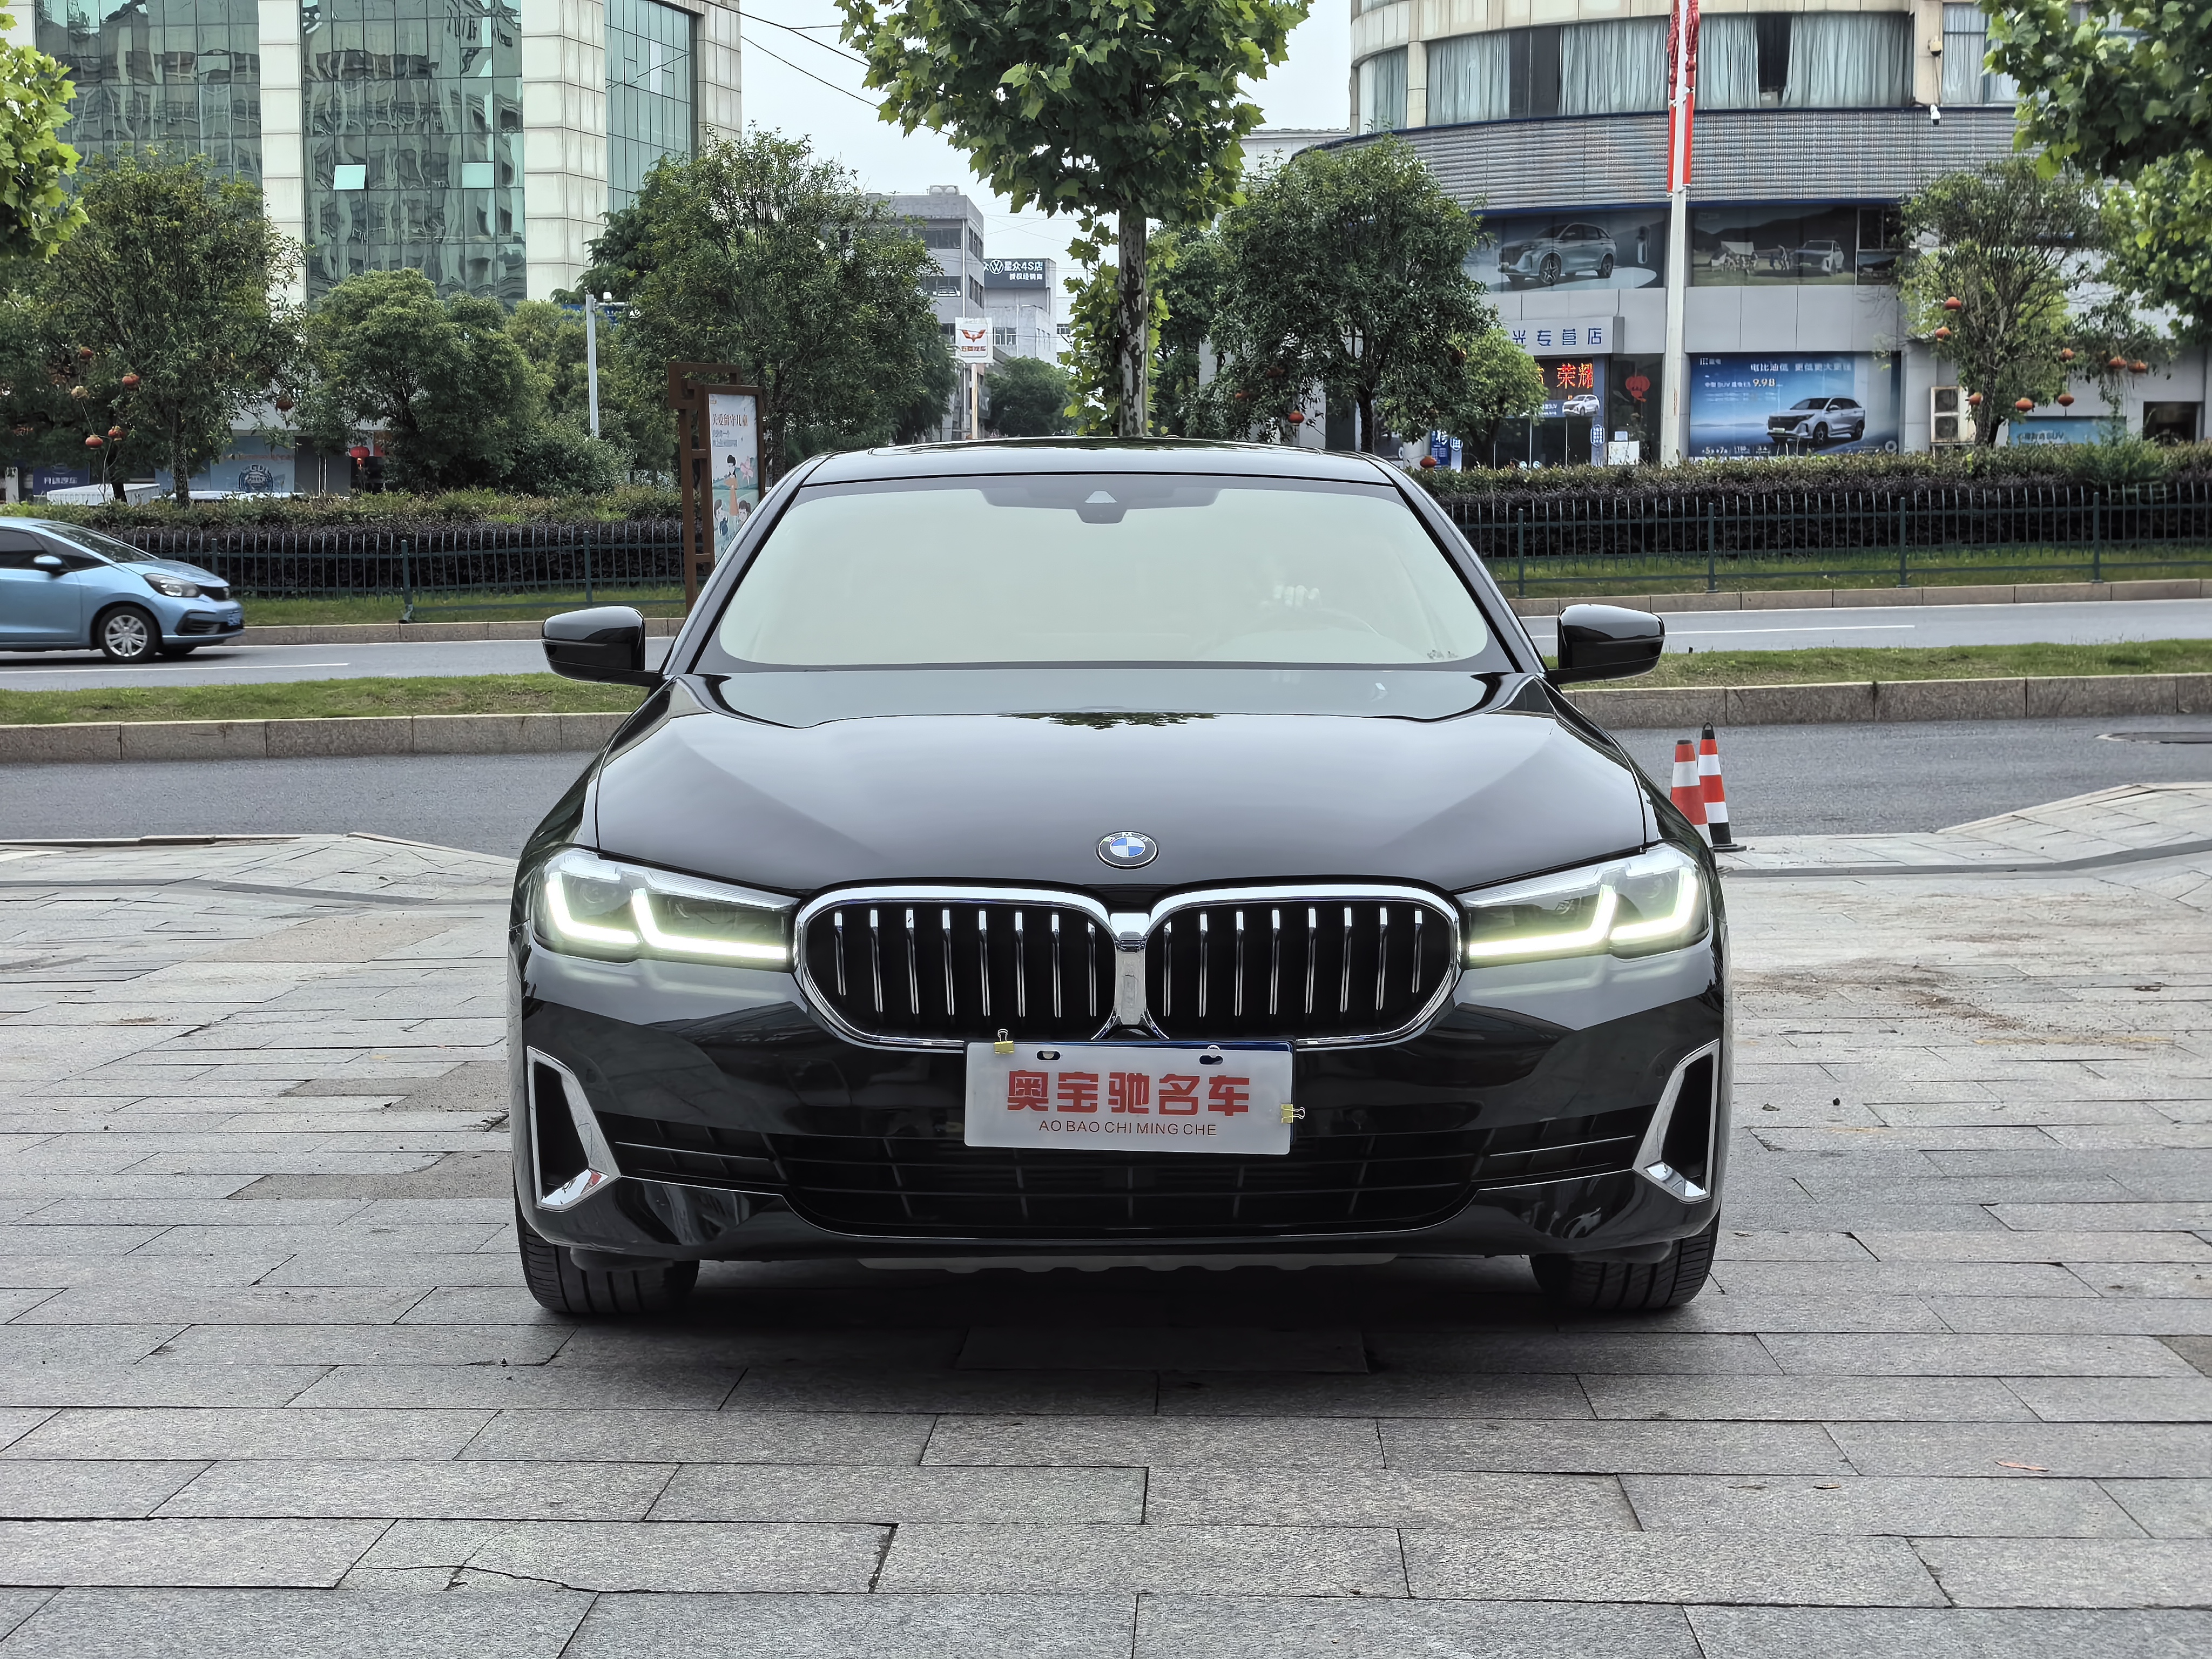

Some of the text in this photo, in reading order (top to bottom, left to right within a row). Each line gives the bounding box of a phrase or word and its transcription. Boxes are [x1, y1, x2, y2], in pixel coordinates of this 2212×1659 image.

[1007, 1070, 1250, 1117] 奥宝驰名车
[1038, 1120, 1217, 1136] AO BAO CHI MING CHE
